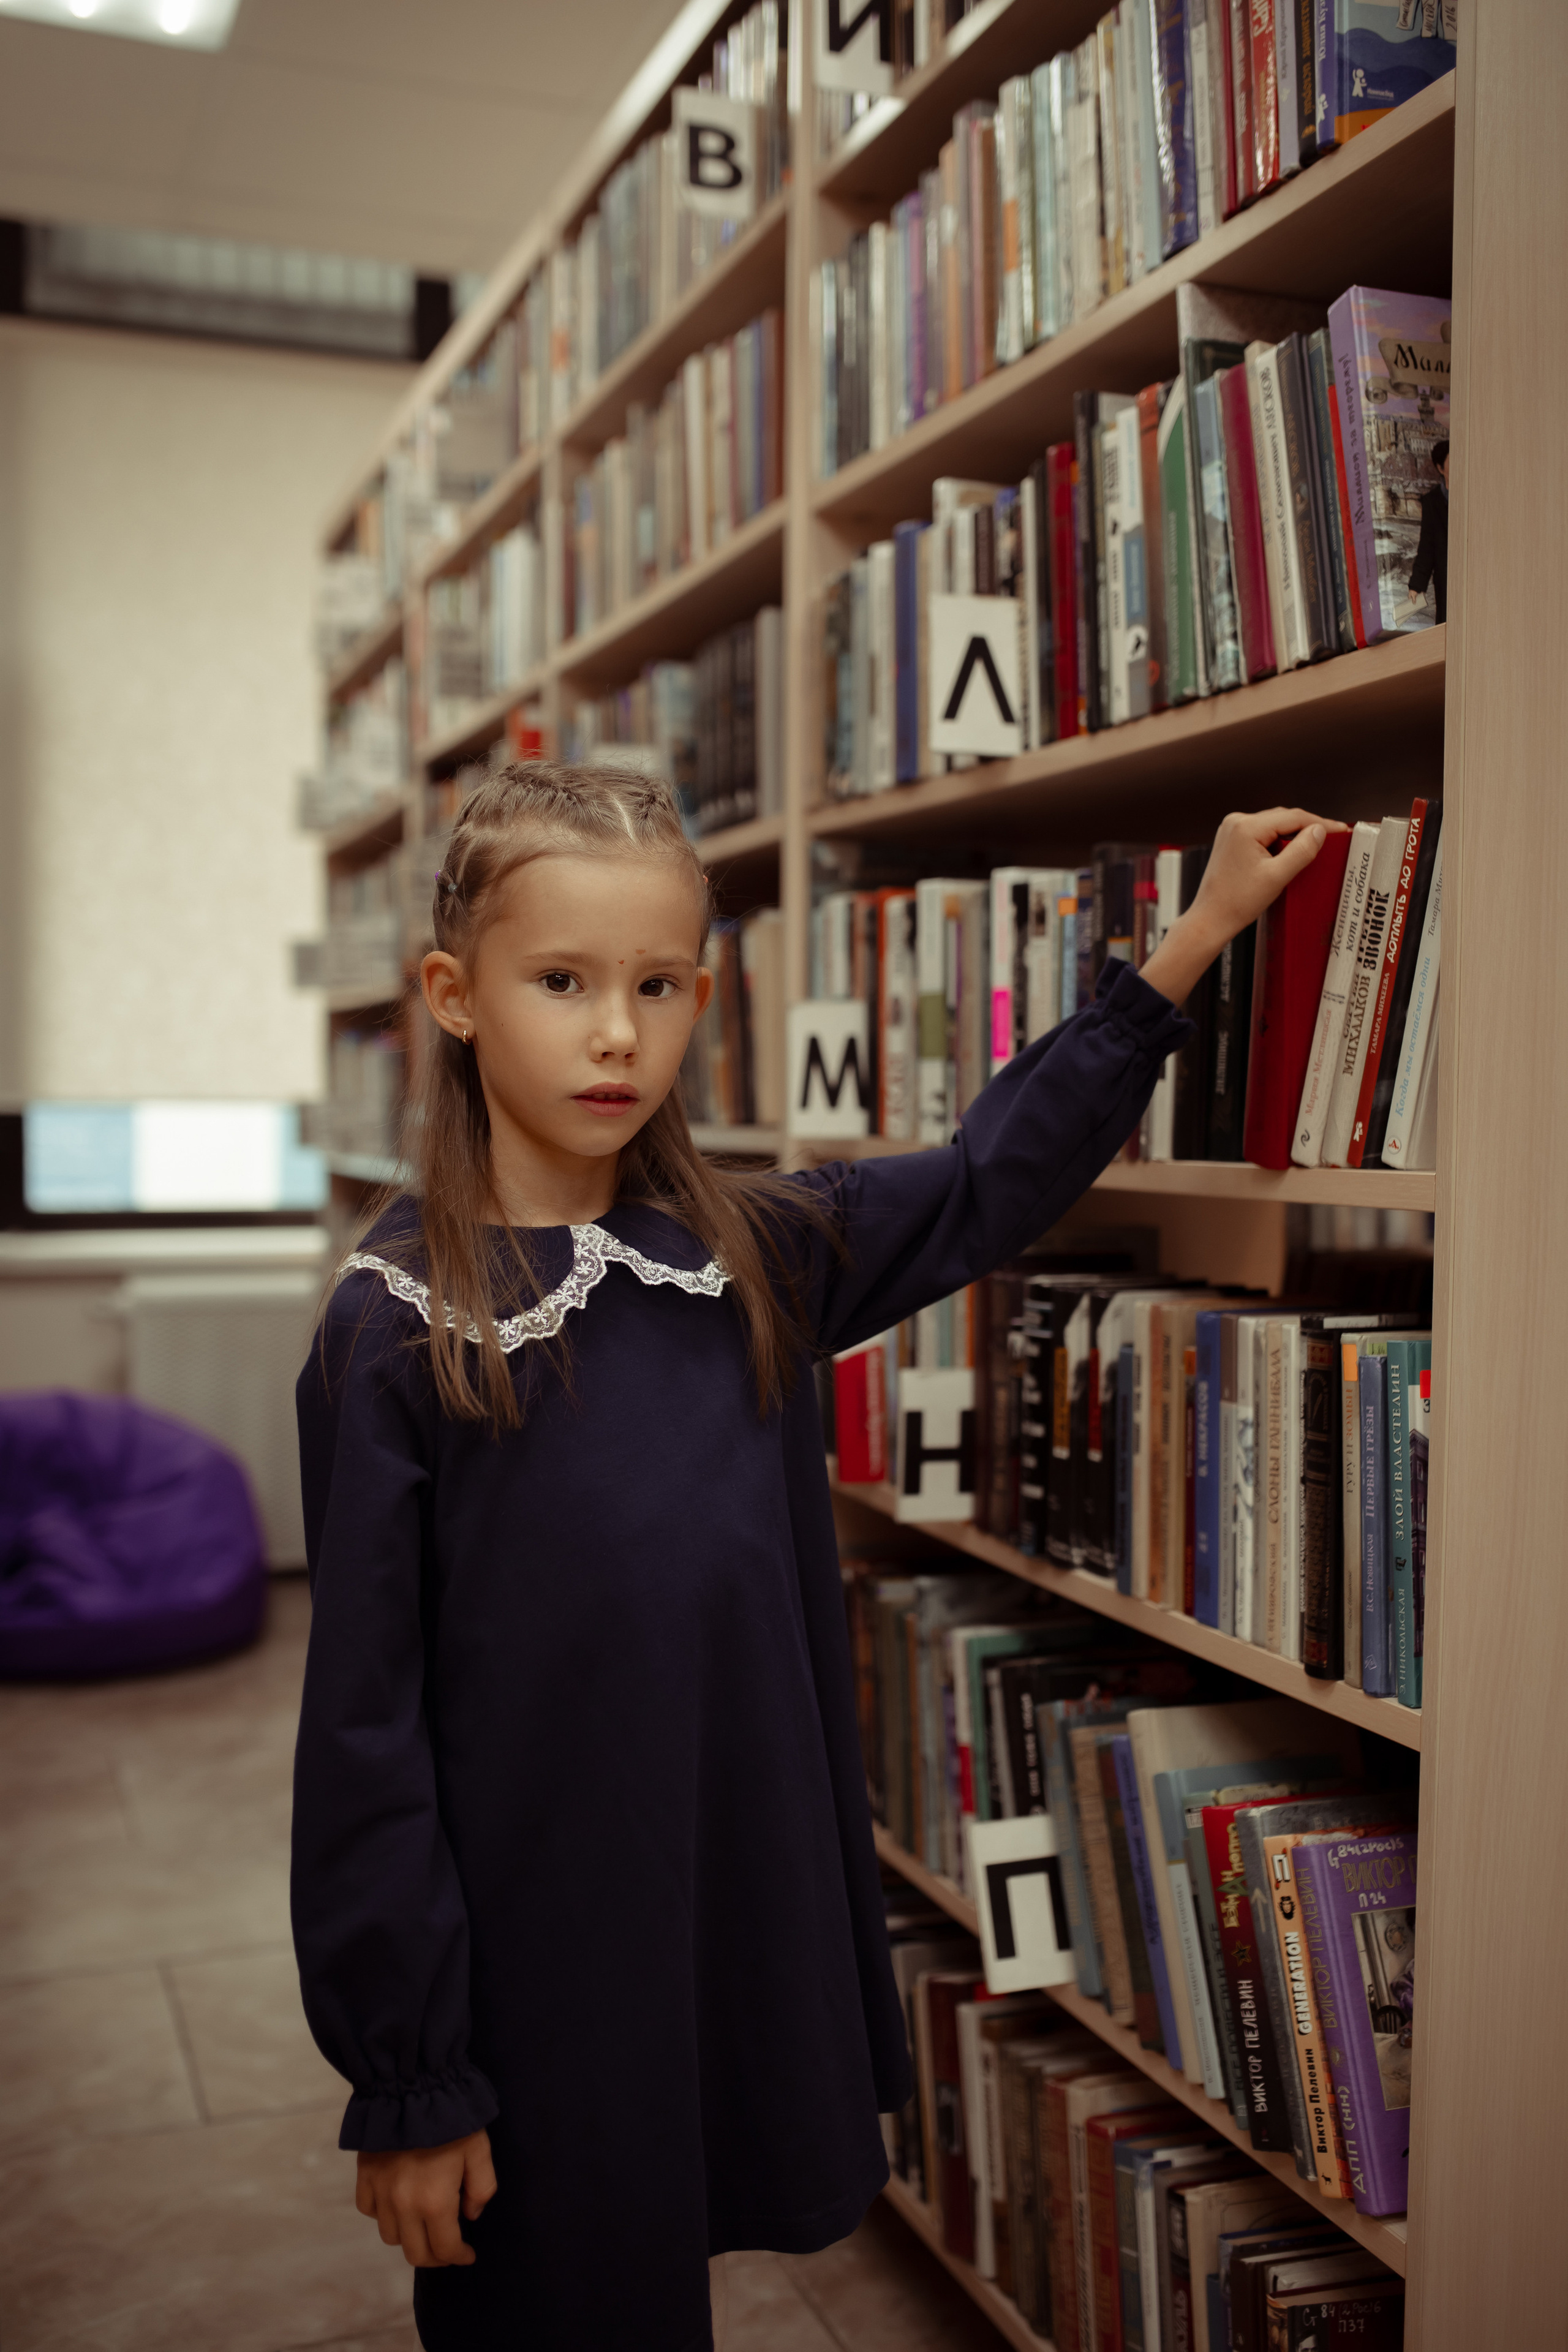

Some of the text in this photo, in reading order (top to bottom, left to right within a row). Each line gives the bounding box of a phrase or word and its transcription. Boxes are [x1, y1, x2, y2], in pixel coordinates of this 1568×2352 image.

[1346, 851, 1371, 951] кот и собака
[1362, 889, 1390, 971] ЗВОНОК
[1386, 817, 1421, 963] ДОПЛЫТЬ ДО ГРОТА
[1427, 897, 1441, 937] Тамара
[1342, 976, 1371, 1077] МИХАЛКОВ
[1370, 972, 1390, 1054] ТАМАРА МИХЕЕВА
[1395, 957, 1431, 1117] Когда мы остаёмся одни
[800, 1036, 870, 1110] М
[903, 1410, 974, 1494] Н
[1268, 1348, 1281, 1525] СЛОНЫ ГАННИБАЛА
[1345, 1389, 1354, 1441] ЗОМБИ
[1363, 1405, 1374, 1518] ПЕРВЫЕ ГРЁЗЫ
[1390, 1363, 1404, 1540] ЗЛОЙ ВЛАСТЕЛИН
[1346, 1458, 1355, 1494] ГУРУ
[986, 1855, 1072, 1960] П
[1341, 1856, 1405, 1893] ВИКТОР
[1284, 1931, 1313, 2035] GENERATION
[1295, 1868, 1338, 2028] ВИКТОР ПЕЛЕВИН
[1237, 1979, 1268, 2113] ВИКТОР ПЕЛЕВИН
[1305, 2048, 1327, 2153] Виктор Пелевин
[1337, 2086, 1366, 2194] ДПП (НН)
